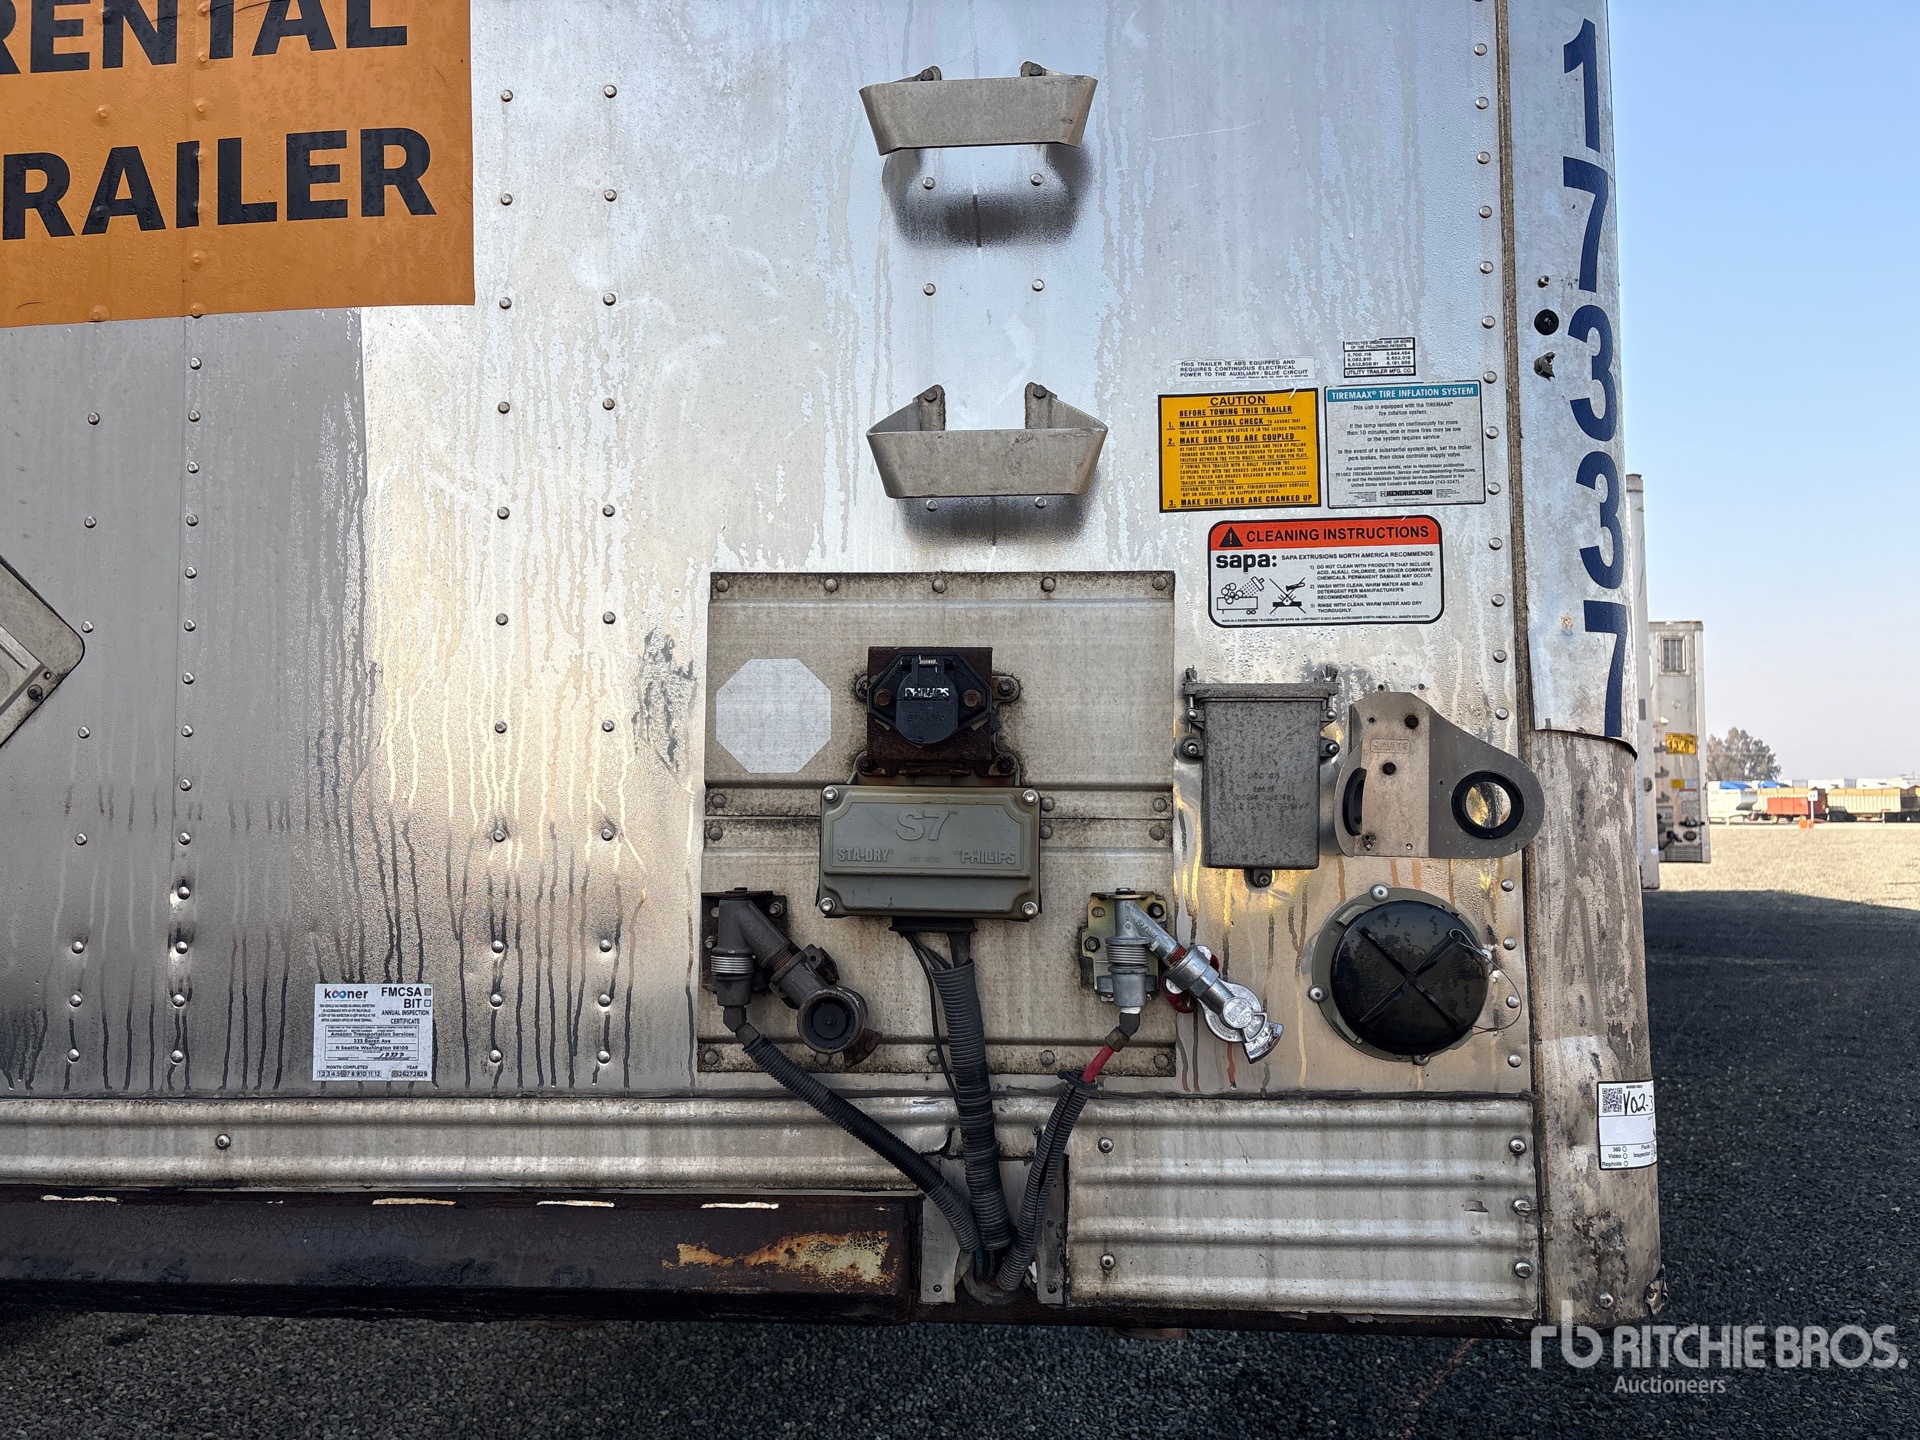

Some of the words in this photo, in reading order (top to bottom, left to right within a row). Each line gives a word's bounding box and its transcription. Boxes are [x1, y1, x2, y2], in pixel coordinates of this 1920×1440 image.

[0, 0, 407, 73] ENAL
[1398, 388, 1439, 397] INFLATION
[1442, 387, 1474, 396] SYSTEM
[1210, 396, 1266, 406] CAUTION
[1246, 529, 1319, 542] CLEANING
[1323, 526, 1429, 540] INSTRUCTIONS
[904, 687, 949, 697] PHILLIPS
[960, 850, 1016, 864] PHILLIPS
[324, 988, 368, 999] kooner
[382, 987, 422, 996] FMCSA
[404, 999, 422, 1008] BIT
